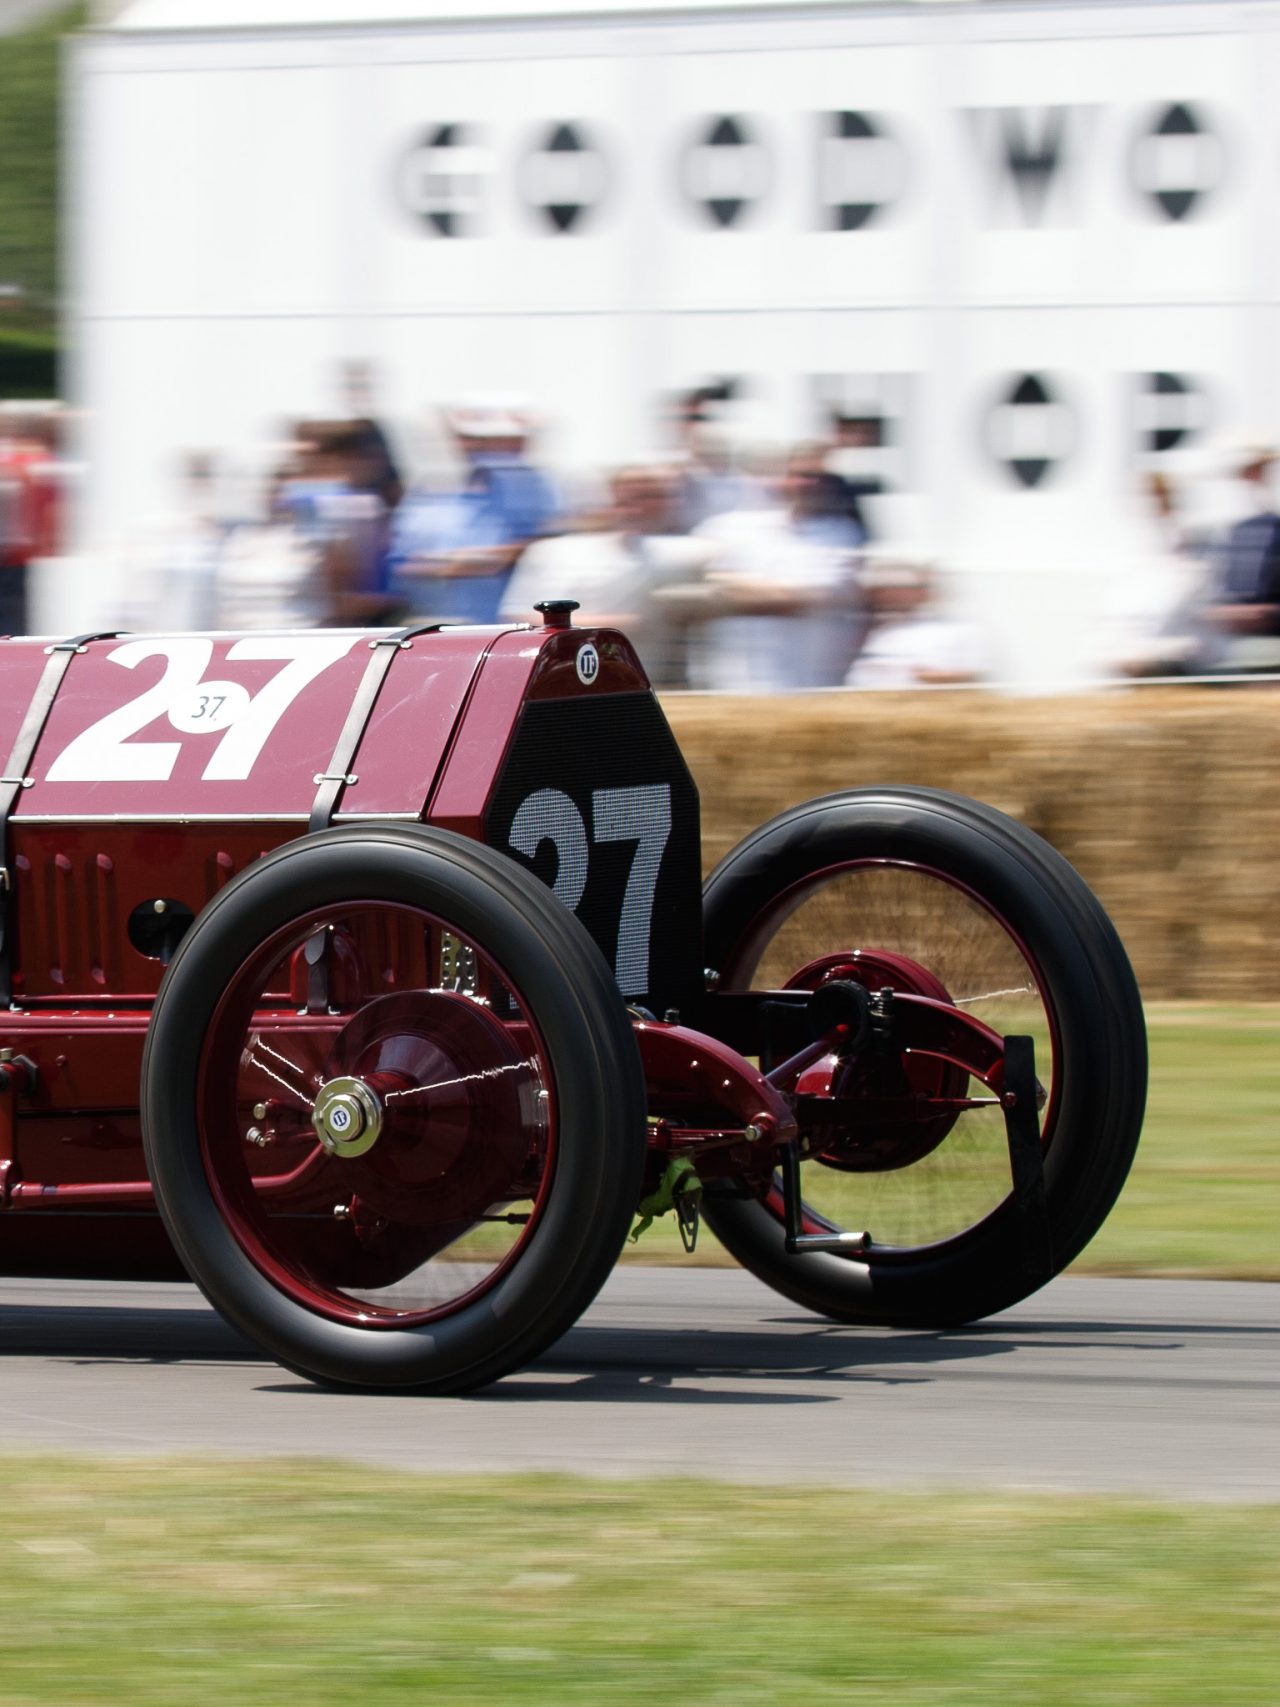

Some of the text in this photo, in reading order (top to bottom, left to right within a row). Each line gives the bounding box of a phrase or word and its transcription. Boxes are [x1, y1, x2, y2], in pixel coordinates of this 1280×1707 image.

[688, 369, 1218, 494] HOP
[45, 636, 365, 782] 27
[191, 696, 227, 718] 37
[509, 783, 672, 996] 27
